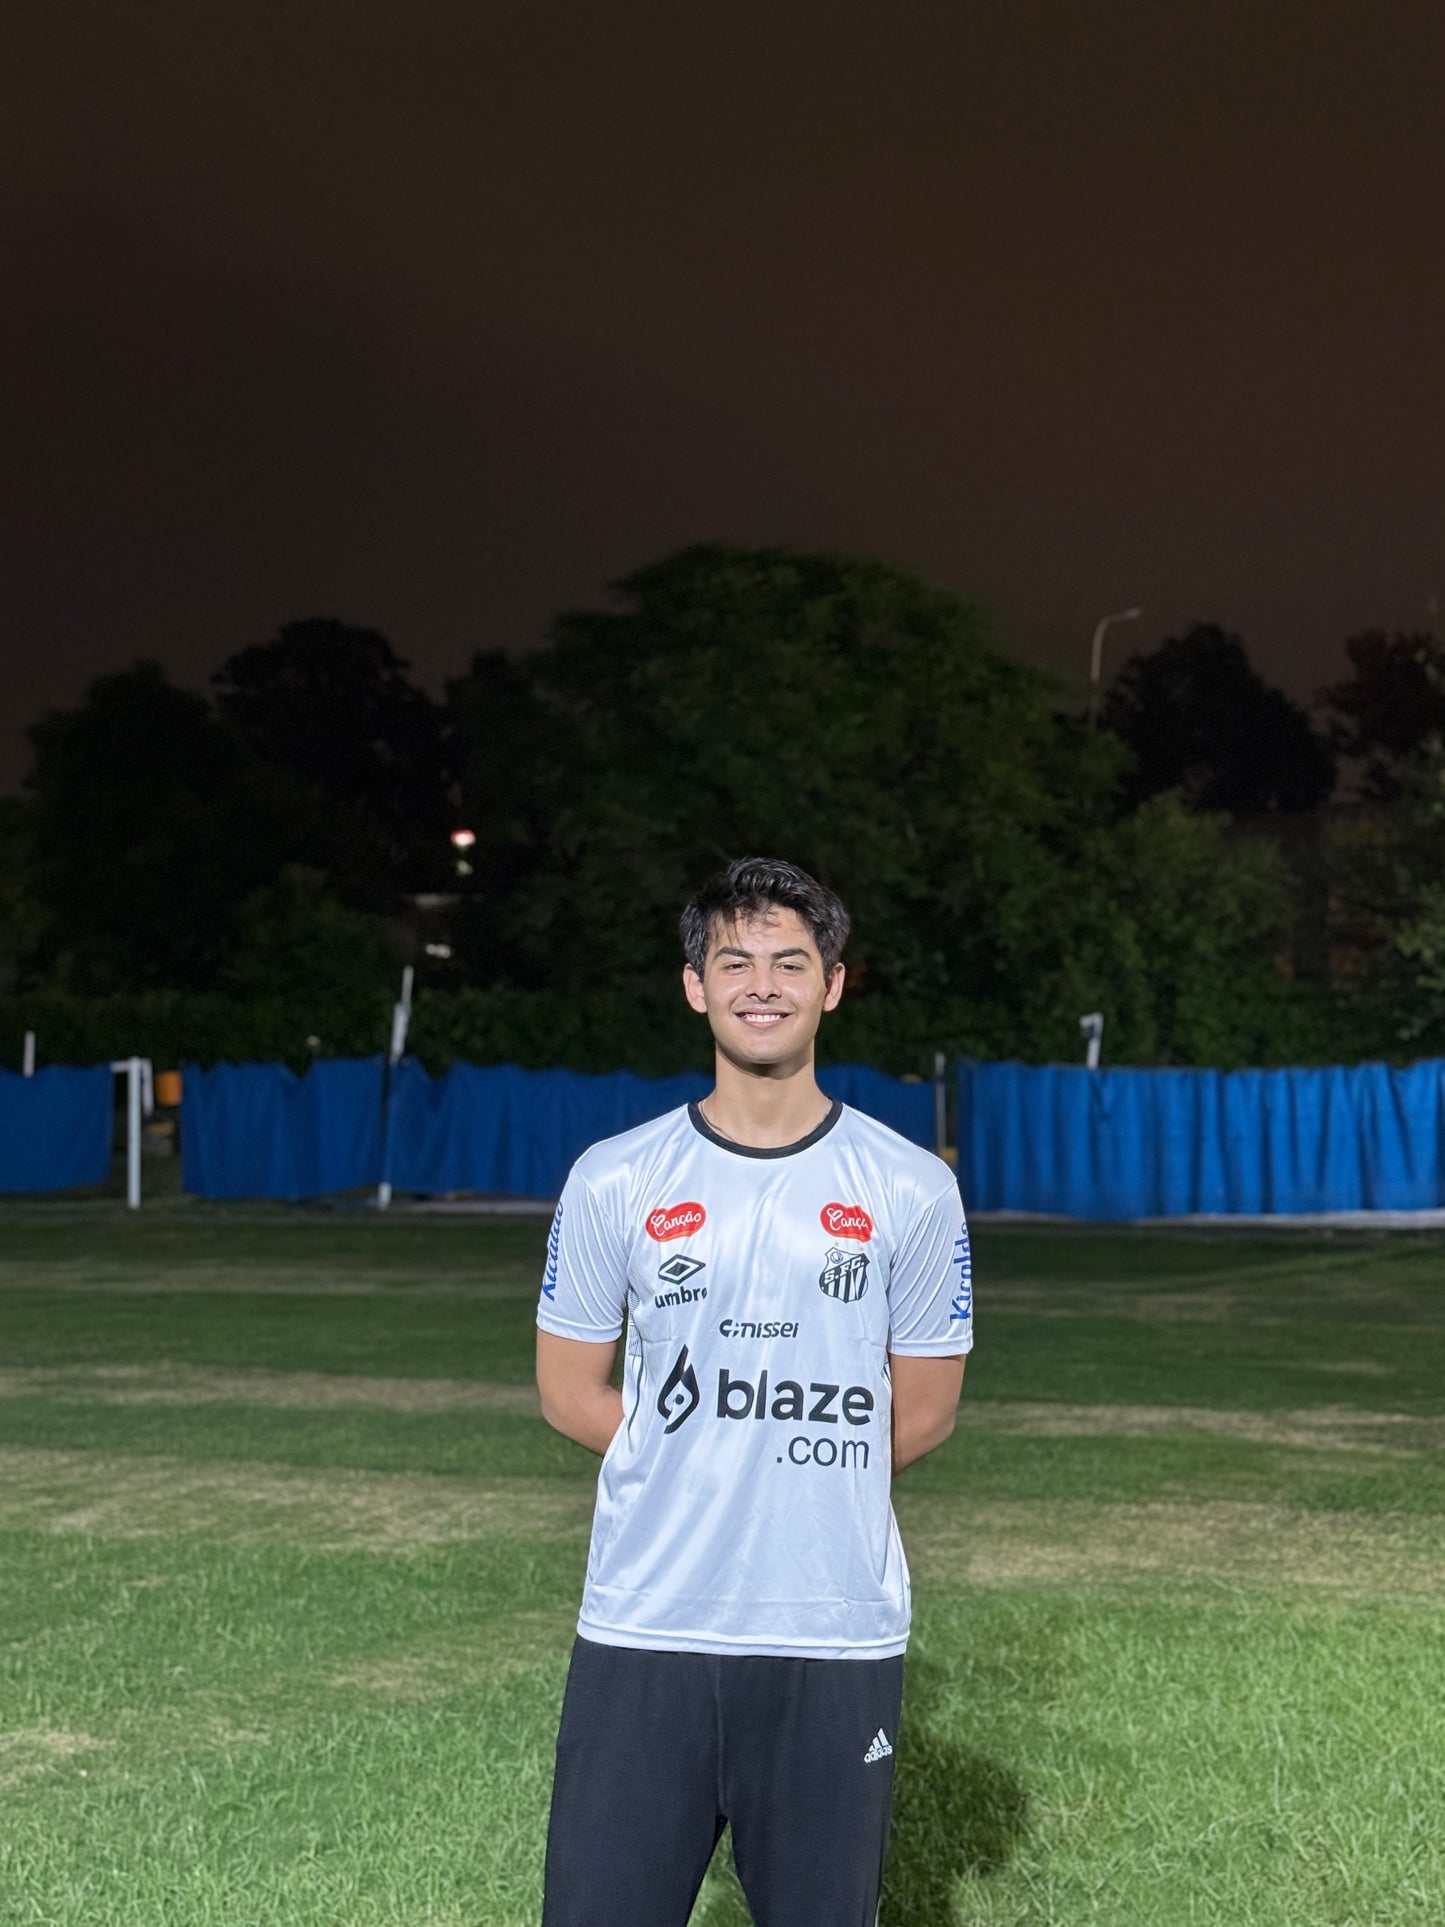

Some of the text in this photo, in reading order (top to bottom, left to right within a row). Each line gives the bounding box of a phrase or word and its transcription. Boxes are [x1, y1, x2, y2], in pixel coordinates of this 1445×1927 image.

[650, 1211, 702, 1237] Canção
[826, 1208, 868, 1232] Canç
[716, 1368, 874, 1426] blaze
[776, 1436, 870, 1469] .com
